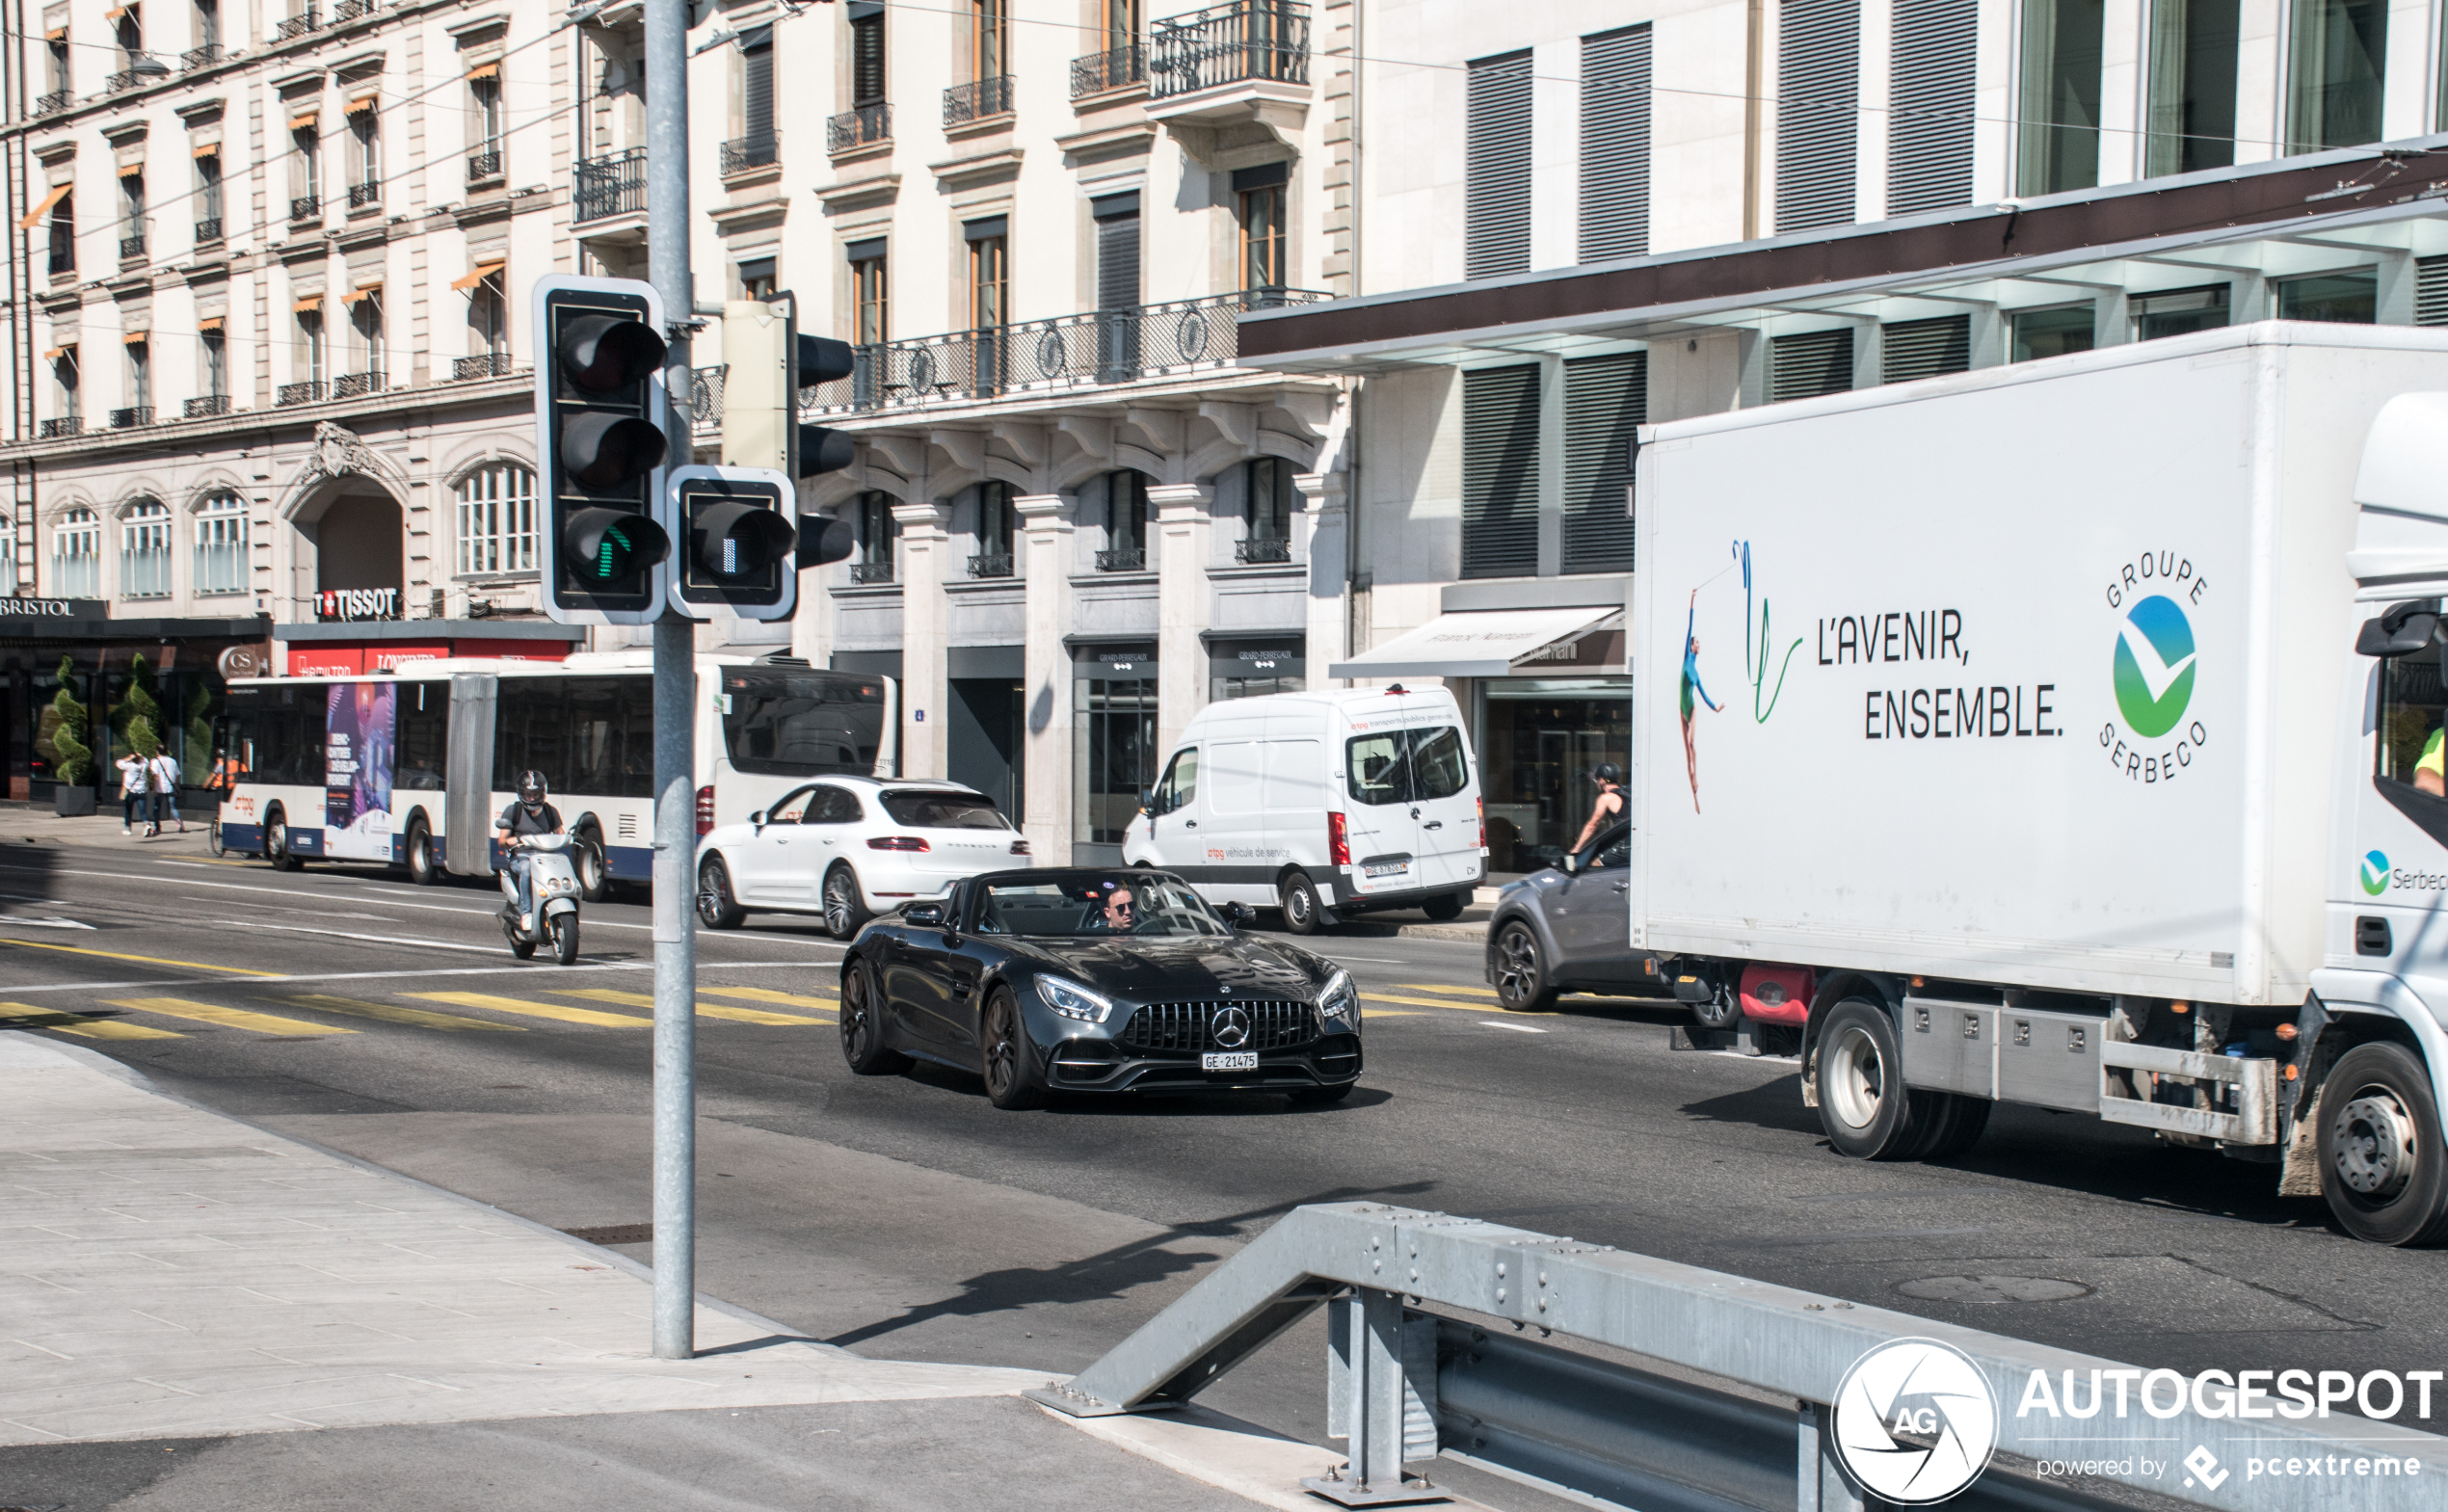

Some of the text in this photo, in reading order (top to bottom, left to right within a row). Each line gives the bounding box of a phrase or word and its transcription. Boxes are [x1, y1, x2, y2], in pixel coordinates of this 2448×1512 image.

[2107, 550, 2208, 606] GROUPE
[0, 598, 74, 616] BRISTOL
[1818, 609, 1969, 666] L'AVENIR,
[229, 653, 251, 669] CS
[1866, 684, 2063, 739] ENSEMBLE.
[2099, 721, 2207, 783] SERBECO
[1255, 847, 1265, 858] de
[1266, 848, 1290, 858] service
[1466, 866, 1476, 876] CH
[2393, 868, 2448, 890] Serbec
